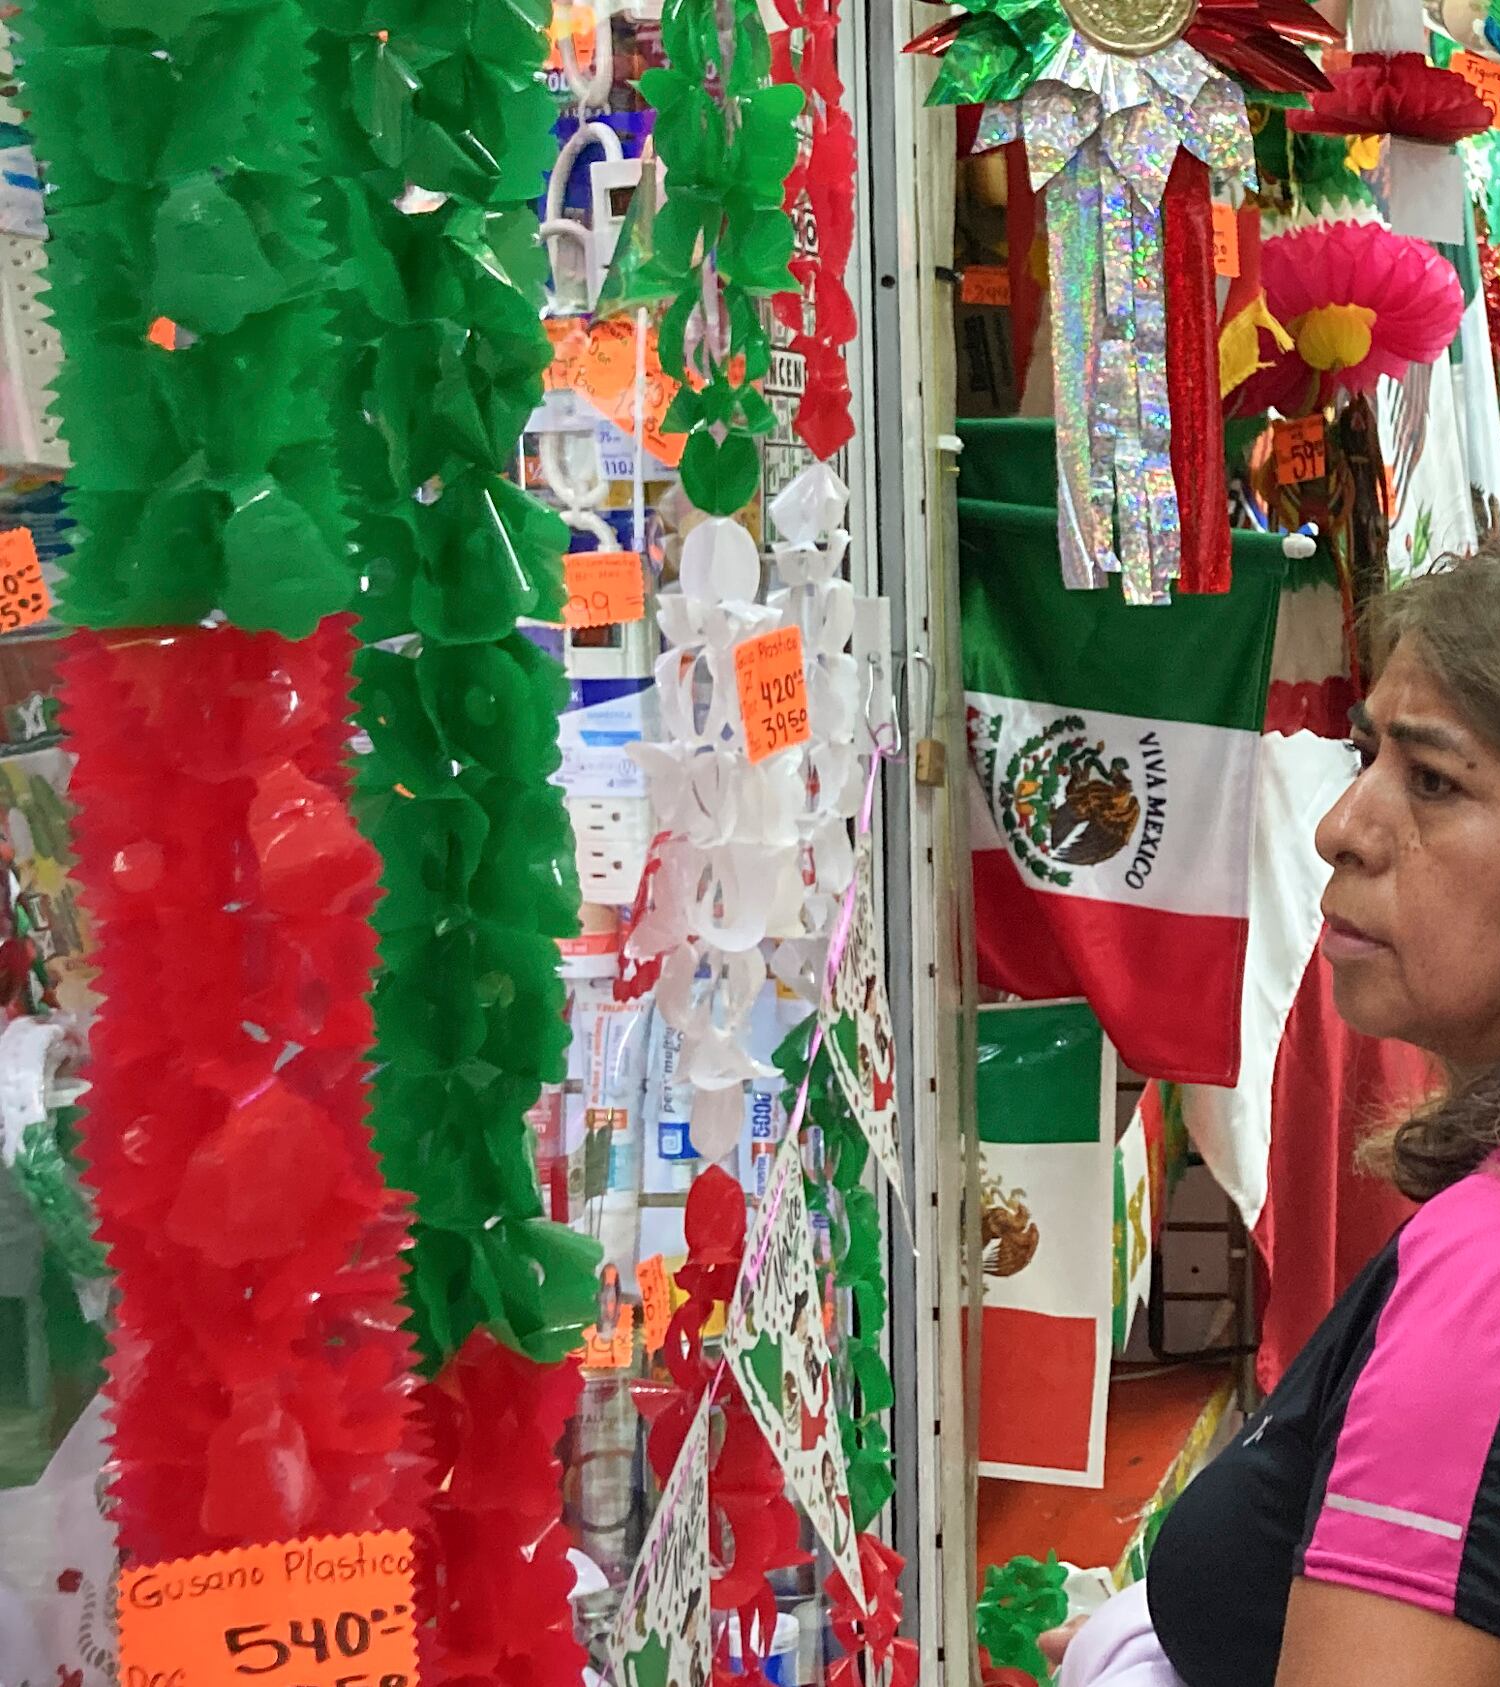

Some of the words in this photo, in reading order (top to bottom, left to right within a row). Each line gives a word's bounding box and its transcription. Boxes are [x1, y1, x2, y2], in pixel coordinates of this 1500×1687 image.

[1138, 731, 1168, 789] VIVA
[1124, 795, 1168, 891] MEXICO
[129, 1565, 264, 1609] Gusano
[285, 1541, 411, 1583] Plastico
